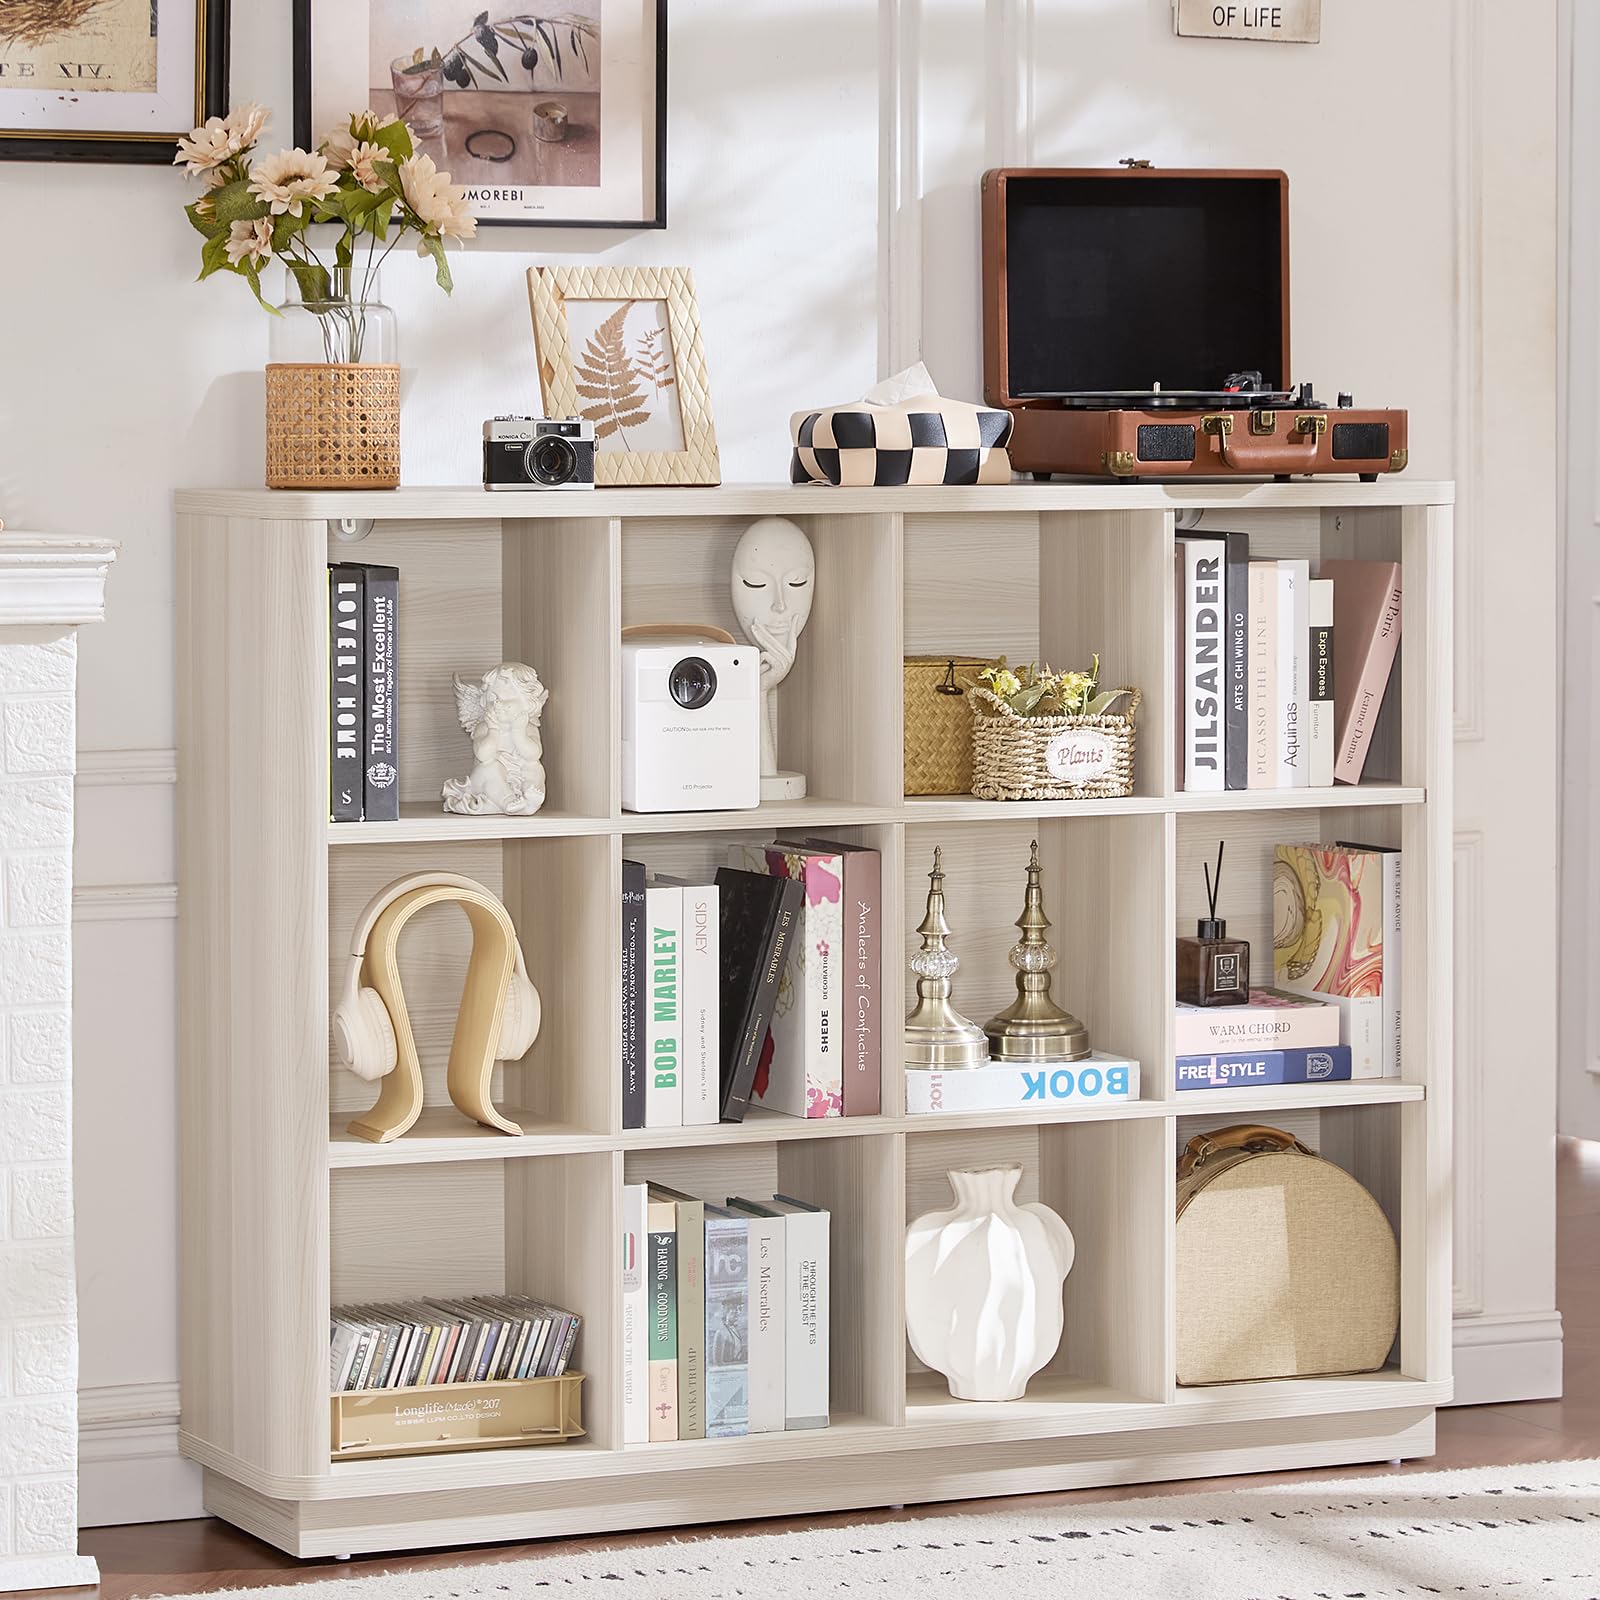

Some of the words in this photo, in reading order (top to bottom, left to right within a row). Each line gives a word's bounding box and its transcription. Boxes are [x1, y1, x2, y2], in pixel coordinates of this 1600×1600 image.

[1213, 6, 1236, 27] OF
[1244, 7, 1281, 28] LIFE
[461, 189, 523, 201] MOREBI
[1392, 589, 1402, 602] In
[337, 583, 356, 685] LOVELY
[373, 596, 386, 672] Excellent
[1235, 613, 1244, 627] LO
[1257, 616, 1266, 656] LINE
[1382, 606, 1399, 639] Paris
[1235, 630, 1243, 658] WING
[1318, 631, 1328, 656] Expo
[386, 658, 392, 666] of
[1234, 660, 1243, 680] CHI
[1318, 658, 1328, 697] Express
[372, 677, 385, 718] Most
[1234, 684, 1243, 711] ARTS
[1257, 666, 1266, 701] THE
[1356, 689, 1374, 726] Jeanne
[337, 698, 356, 758] HOME
[371, 723, 384, 754] The
[1257, 708, 1266, 774] PICASSO
[1284, 702, 1300, 767] Aquinas
[1058, 744, 1104, 766] Plants
[1346, 729, 1364, 764] Damas
[694, 902, 708, 954] SIDNEY
[782, 910, 792, 927] LES
[858, 900, 871, 970] Analects
[654, 927, 676, 1022] MARLEY
[766, 932, 786, 984] MISERABLES
[856, 974, 871, 990] of
[855, 995, 870, 1071] Confucius
[1210, 1024, 1246, 1036] WARM
[1248, 1022, 1291, 1034] CHORD
[654, 1038, 676, 1088] BOB
[1220, 1062, 1266, 1078] STYLE
[930, 1074, 943, 1110] 2011
[1020, 1066, 1128, 1100] BOOK
[760, 1238, 771, 1259] Les
[802, 1260, 808, 1272] OF
[760, 1266, 771, 1332] Miserables
[688, 1347, 696, 1388] TRUMP
[394, 1402, 444, 1418] Longlife
[482, 1398, 500, 1409] 207
[688, 1389, 696, 1432] IVANKA
